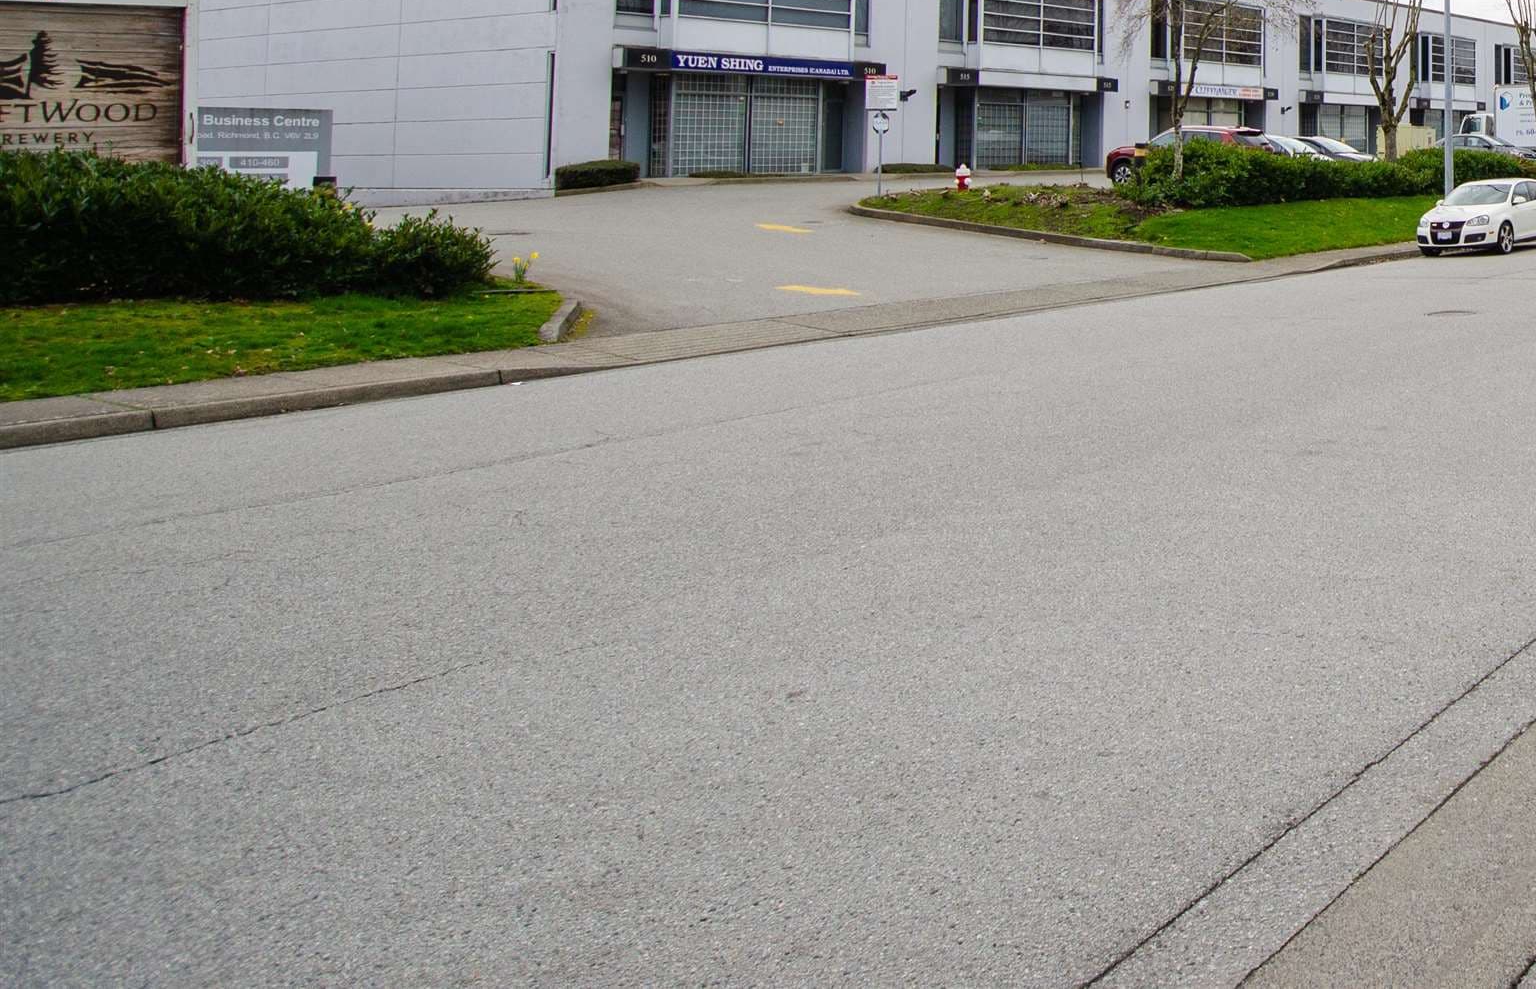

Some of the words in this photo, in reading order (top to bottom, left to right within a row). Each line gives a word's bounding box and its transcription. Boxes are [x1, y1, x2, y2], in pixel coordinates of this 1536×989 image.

[640, 54, 657, 63] 510
[676, 54, 718, 69] YUEN
[721, 57, 764, 71] SHING
[768, 65, 808, 74] ENTERPRISES
[203, 114, 270, 127] Business
[273, 115, 320, 128] Centre
